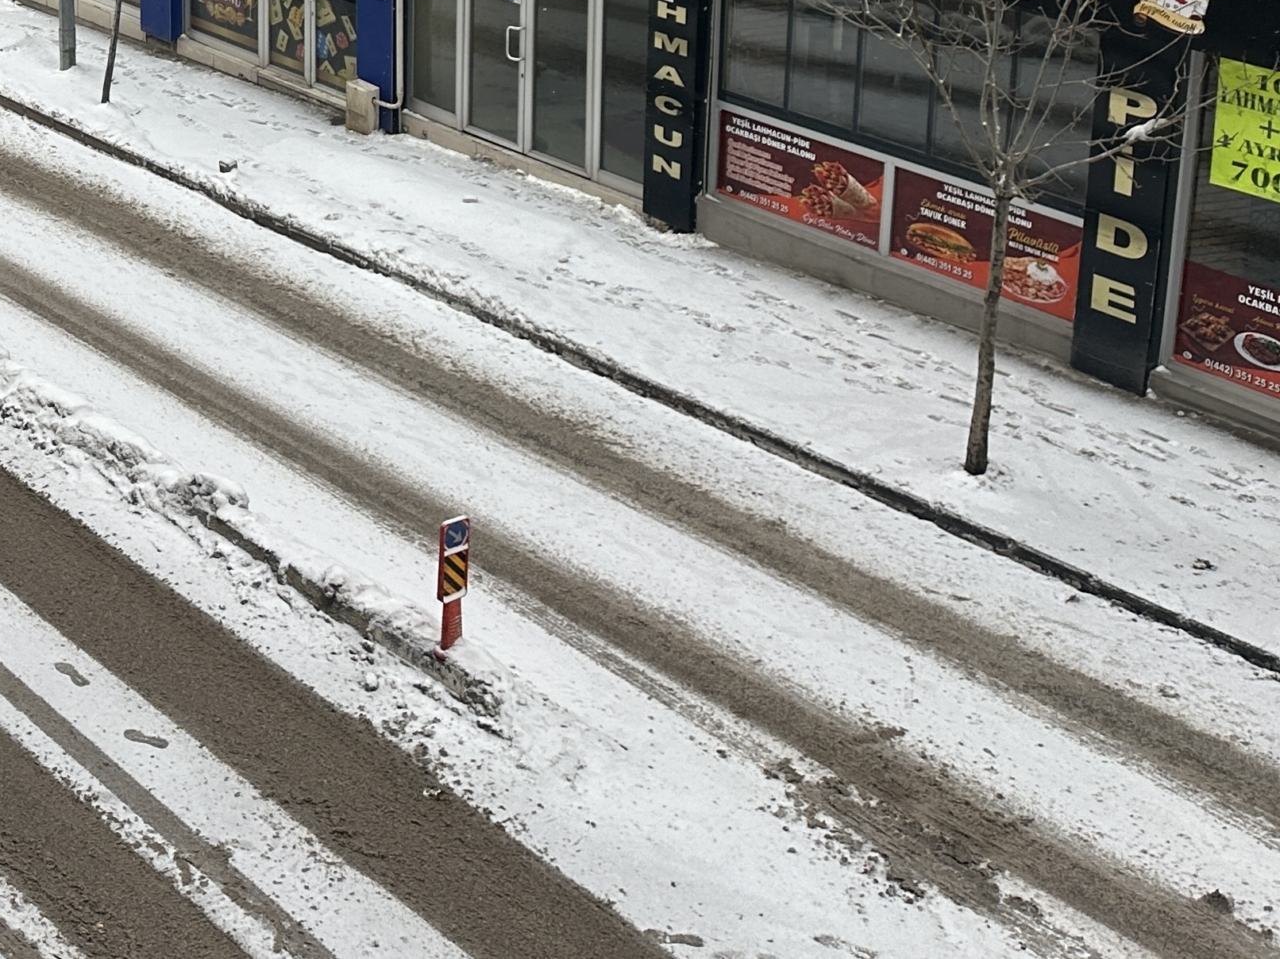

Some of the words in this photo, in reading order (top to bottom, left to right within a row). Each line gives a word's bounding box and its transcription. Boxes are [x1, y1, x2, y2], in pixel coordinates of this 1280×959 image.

[731, 116, 751, 129] YEŞİL
[726, 124, 761, 144] OCAKBAŞI
[761, 137, 787, 152] DÖNER
[787, 143, 816, 161] SALONU
[740, 189, 759, 204] 0(442)
[759, 196, 771, 207] 351
[771, 200, 780, 210] 25
[780, 203, 790, 213] 25
[943, 183, 964, 197] YEŞİL
[936, 191, 974, 209] OCAKBAŞI
[974, 203, 995, 217] DÖNE
[1008, 214, 1033, 229] ALONU
[1090, 86, 1158, 325] PİDE
[920, 207, 943, 223] TAVUK
[943, 214, 967, 230] DÖNER
[916, 253, 938, 268] 0(442)
[938, 260, 952, 271] 351
[952, 265, 962, 276] 25
[962, 268, 973, 280] 25
[1247, 284, 1276, 303] YEŞİL
[1204, 358, 1234, 378] 0(442)
[1234, 369, 1253, 383] 351
[1254, 375, 1267, 388] 25
[1267, 381, 1280, 393] 25
